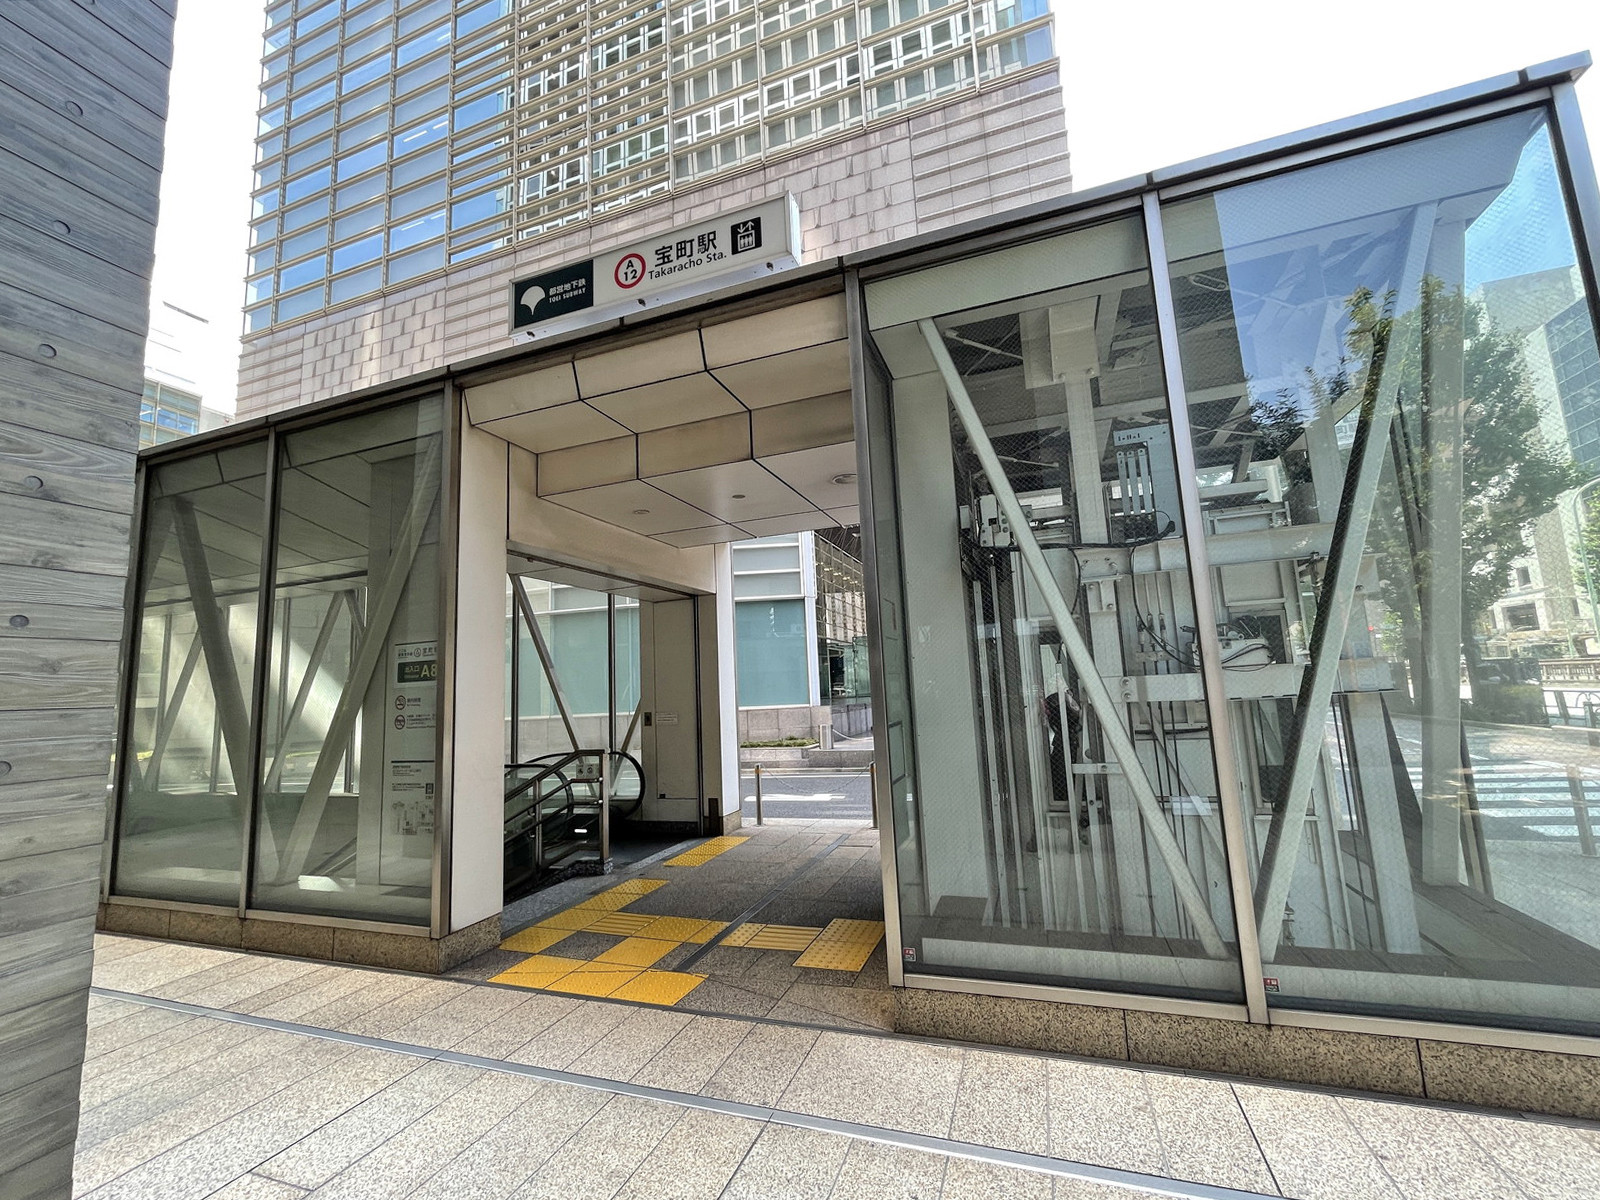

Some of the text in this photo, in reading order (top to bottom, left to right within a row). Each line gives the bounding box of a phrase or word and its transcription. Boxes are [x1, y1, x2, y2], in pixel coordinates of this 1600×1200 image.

[655, 230, 718, 268] 宝町駅
[626, 259, 634, 270] A
[648, 251, 727, 280] Takaracho Sta.
[623, 268, 638, 281] 12
[549, 278, 586, 296] 都営地下鉄
[549, 287, 586, 303] TOEI SUBWAY
[420, 663, 437, 678] A8
